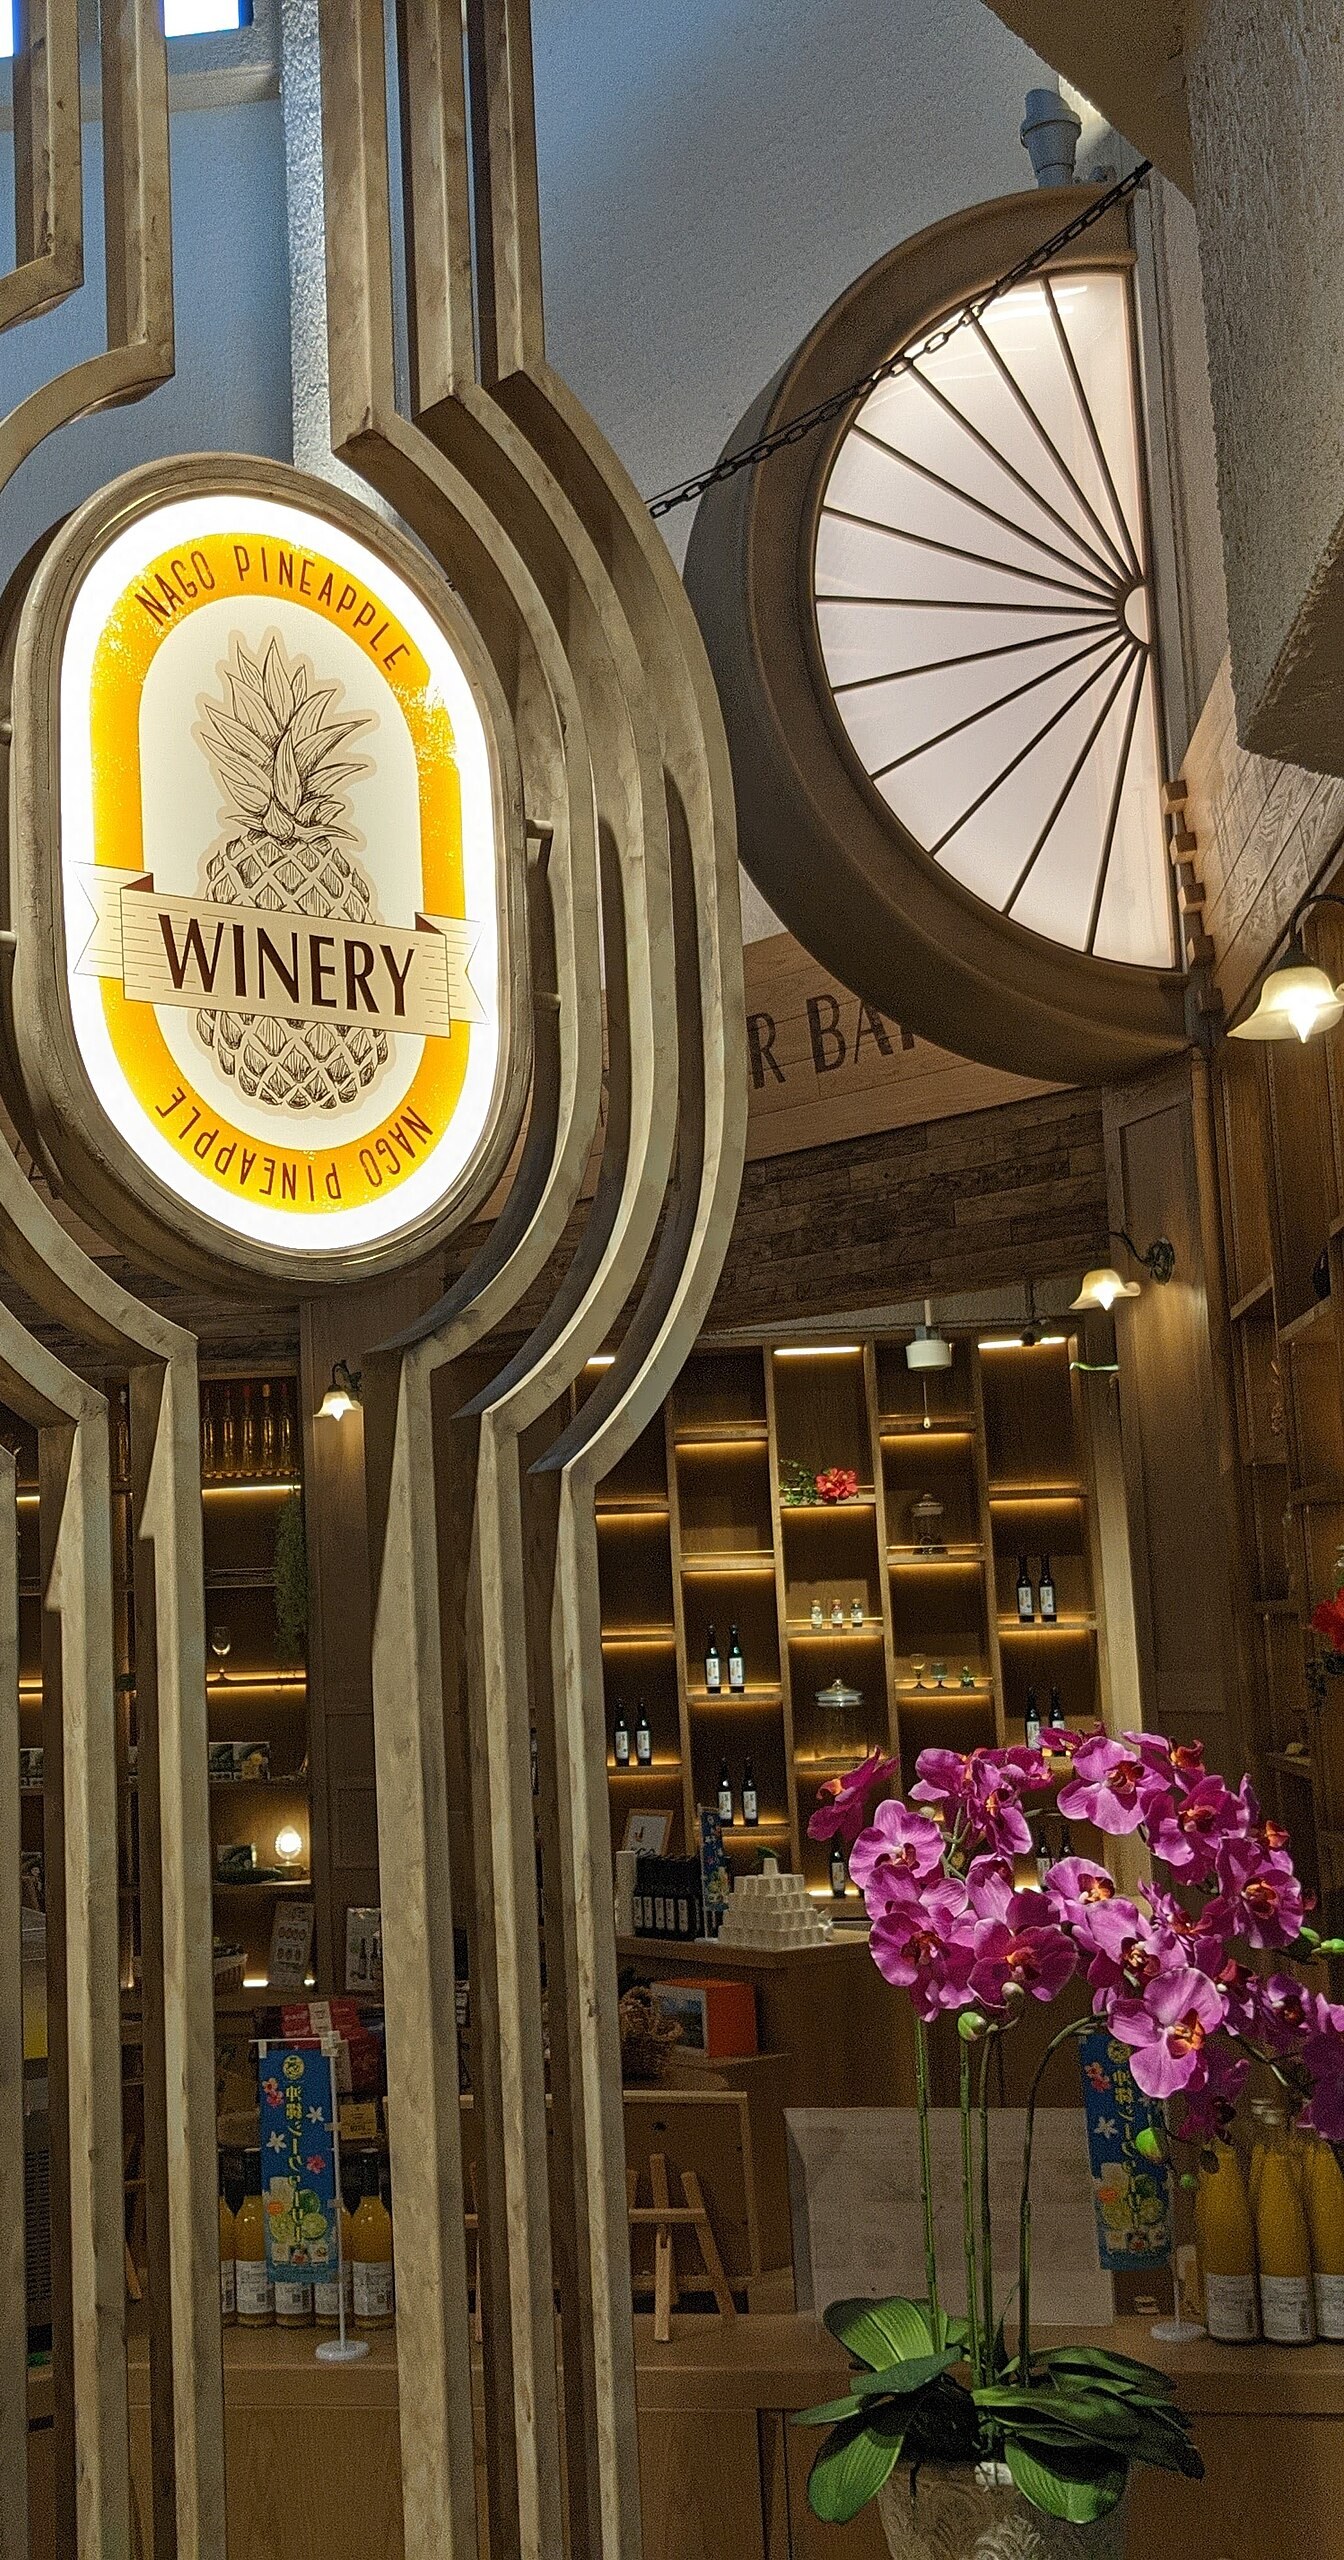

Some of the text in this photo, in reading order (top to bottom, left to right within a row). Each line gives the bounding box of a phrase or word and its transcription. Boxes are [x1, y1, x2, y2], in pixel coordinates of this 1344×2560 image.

[135, 545, 411, 671] NAGO PINEAPPLE
[158, 913, 415, 1017] WINERY
[155, 1086, 342, 1202] PINEAPPLE
[358, 1106, 434, 1188] NAGO
